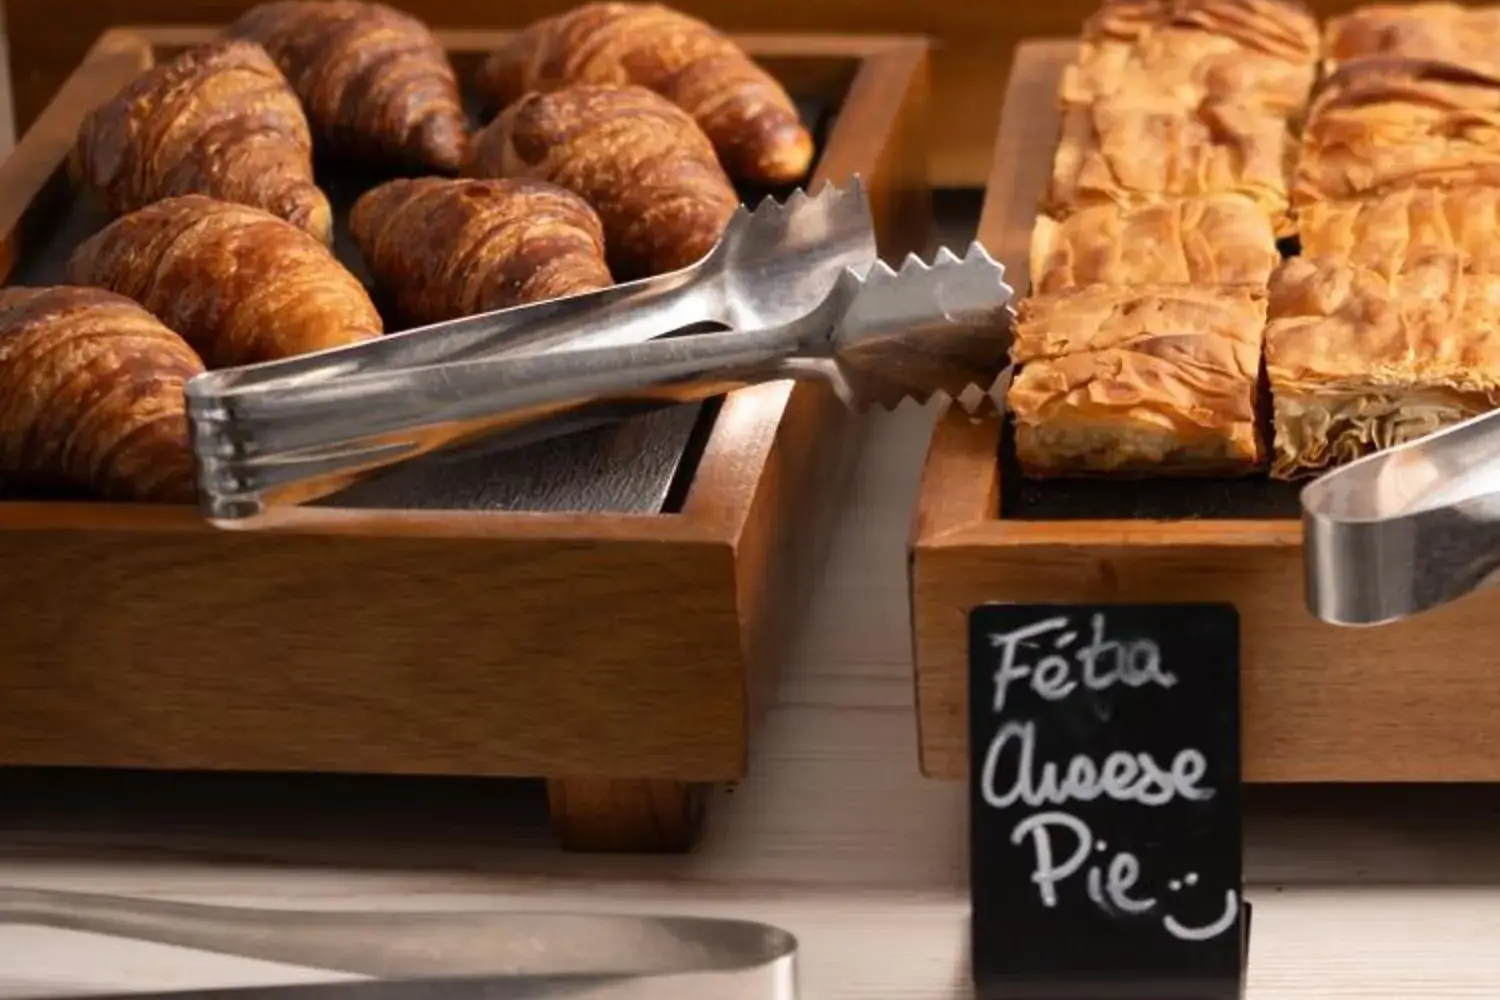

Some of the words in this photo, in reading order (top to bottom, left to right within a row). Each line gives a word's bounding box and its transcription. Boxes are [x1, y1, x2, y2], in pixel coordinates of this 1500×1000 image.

[991, 613, 1178, 711] Féta
[982, 720, 1216, 807] Cheese
[1011, 811, 1156, 912] Pie
